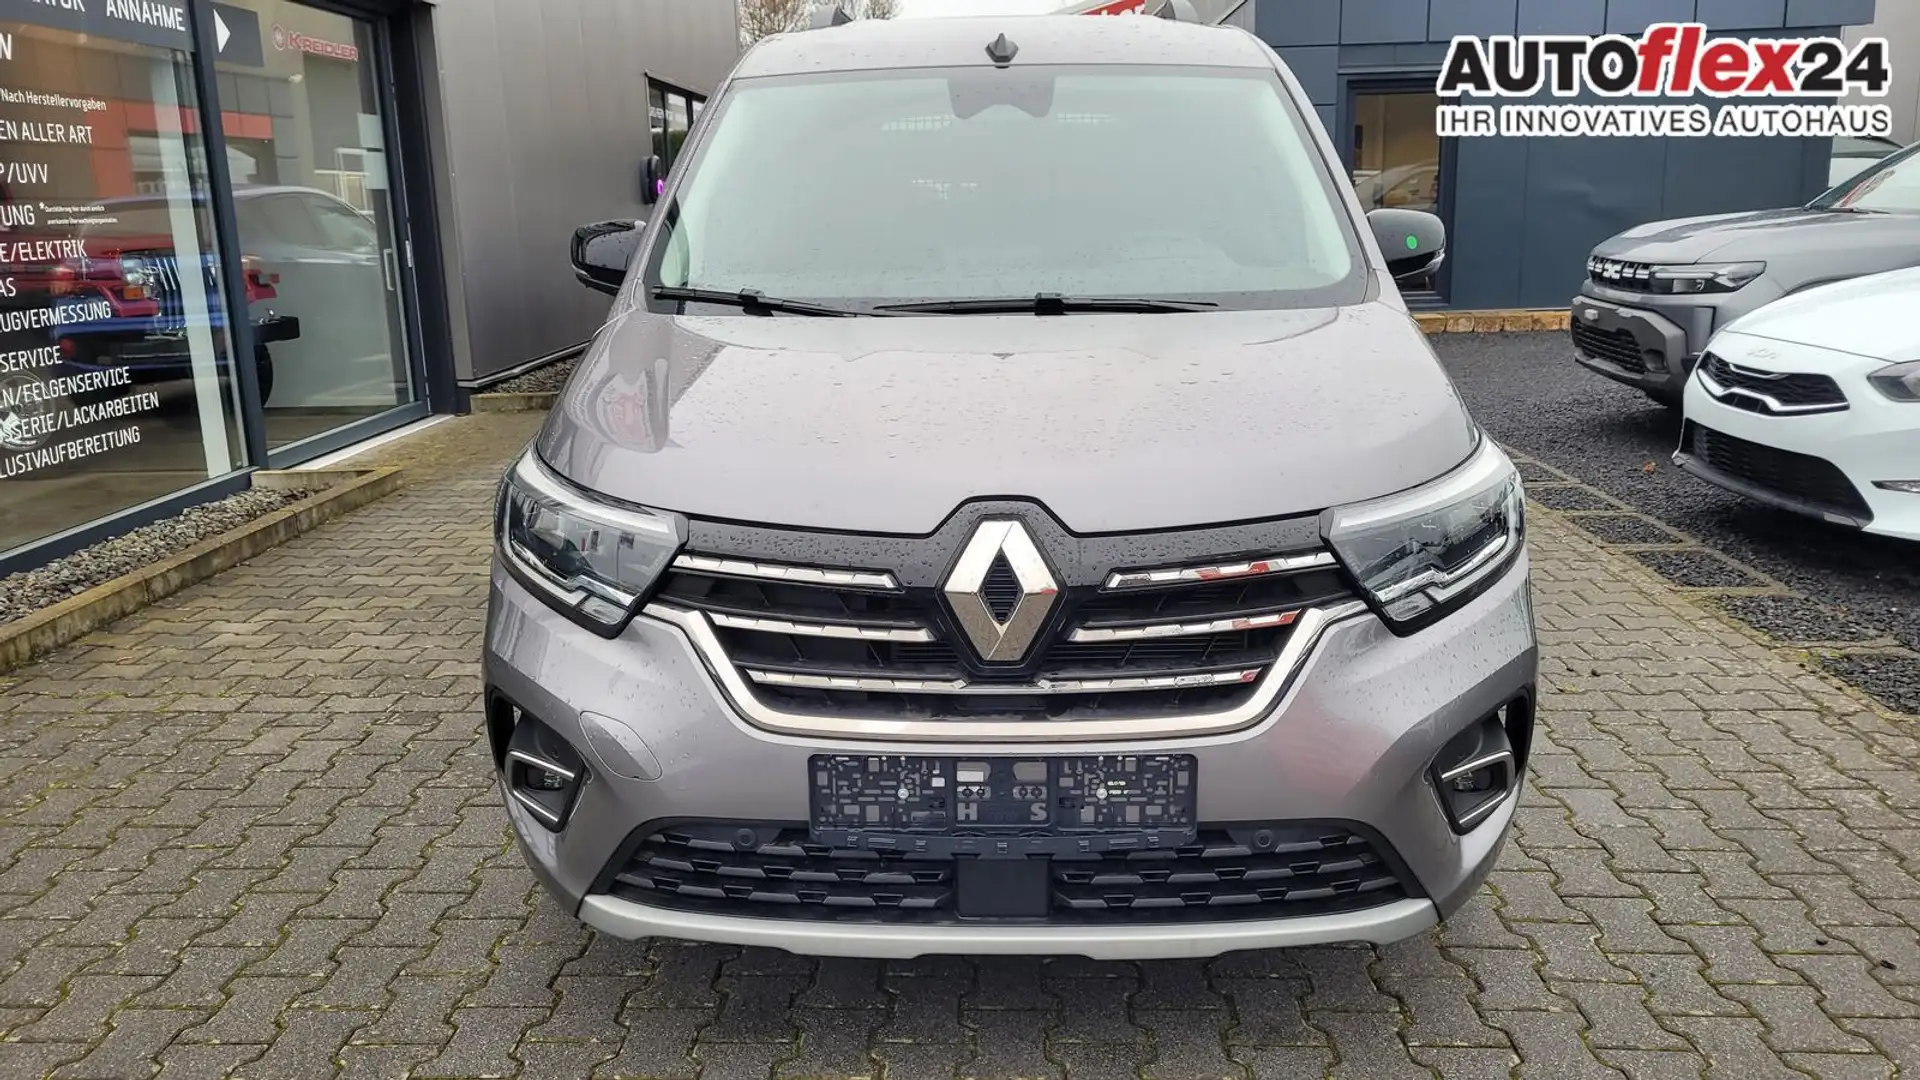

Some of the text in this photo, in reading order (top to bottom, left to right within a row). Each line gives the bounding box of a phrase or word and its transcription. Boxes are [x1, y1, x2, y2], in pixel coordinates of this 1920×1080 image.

[106, 0, 186, 31] ANNAHME
[288, 30, 359, 62] KREIDLER
[26, 90, 107, 112] Herstellervorgaben
[22, 122, 66, 143] ALLER
[69, 124, 93, 144] ART
[0, 204, 35, 226] UNG
[0, 301, 112, 333] UGVERMESSUNG
[0, 345, 63, 373] SERVICE
